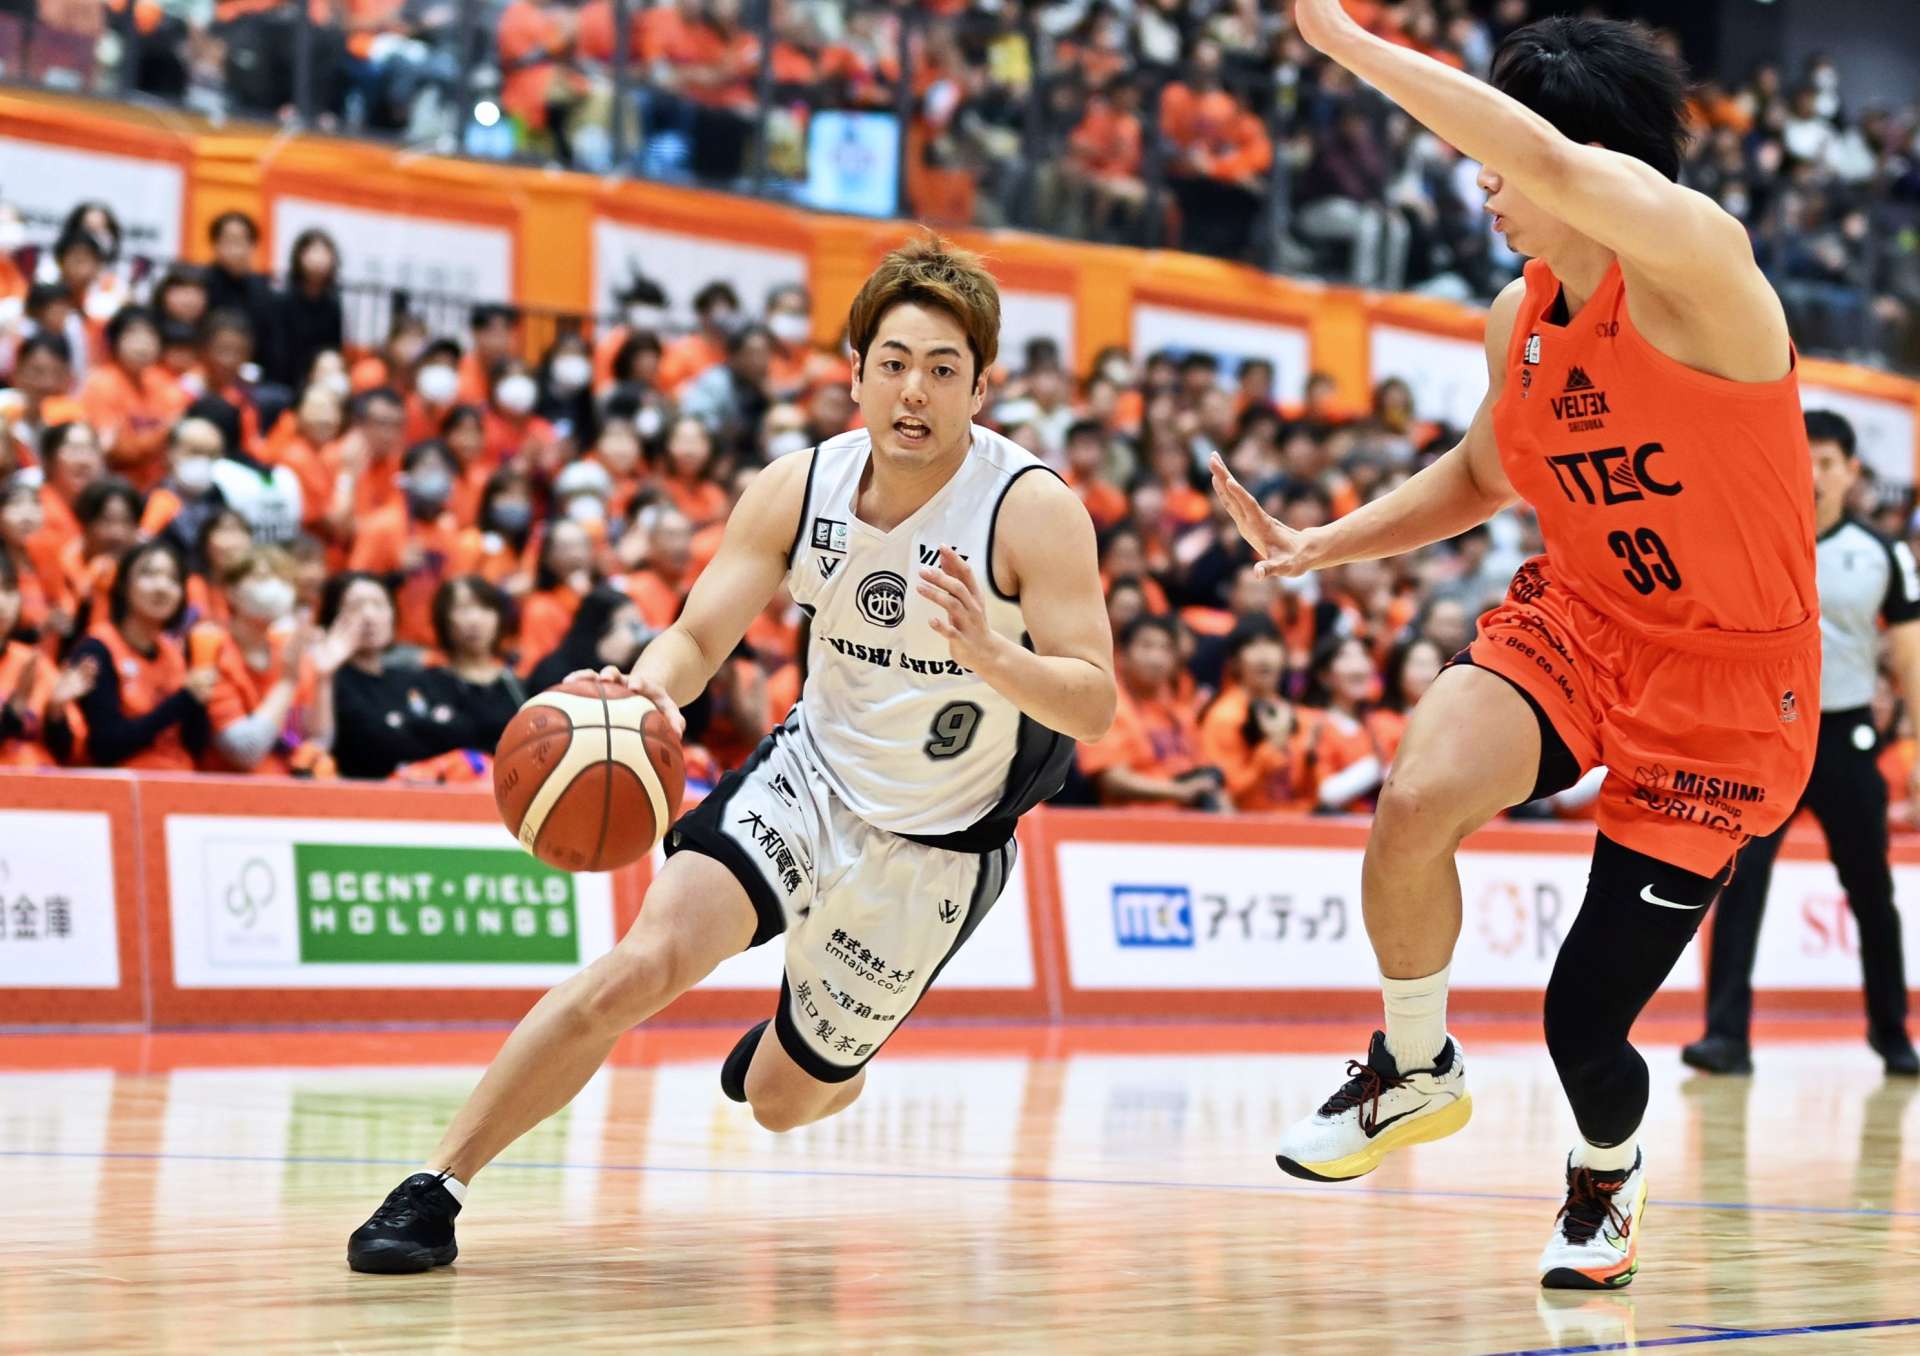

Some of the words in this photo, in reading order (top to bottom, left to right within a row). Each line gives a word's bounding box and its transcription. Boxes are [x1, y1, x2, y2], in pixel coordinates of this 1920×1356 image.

[1545, 442, 1684, 506] ITEC
[1608, 527, 1682, 595] 33
[899, 652, 974, 676] SHUZ
[924, 701, 983, 761] 9
[738, 810, 802, 895] 大和電機
[310, 906, 569, 937] HOLDINGS
[1203, 894, 1347, 940] アイテック
[832, 928, 886, 974] 株式会社
